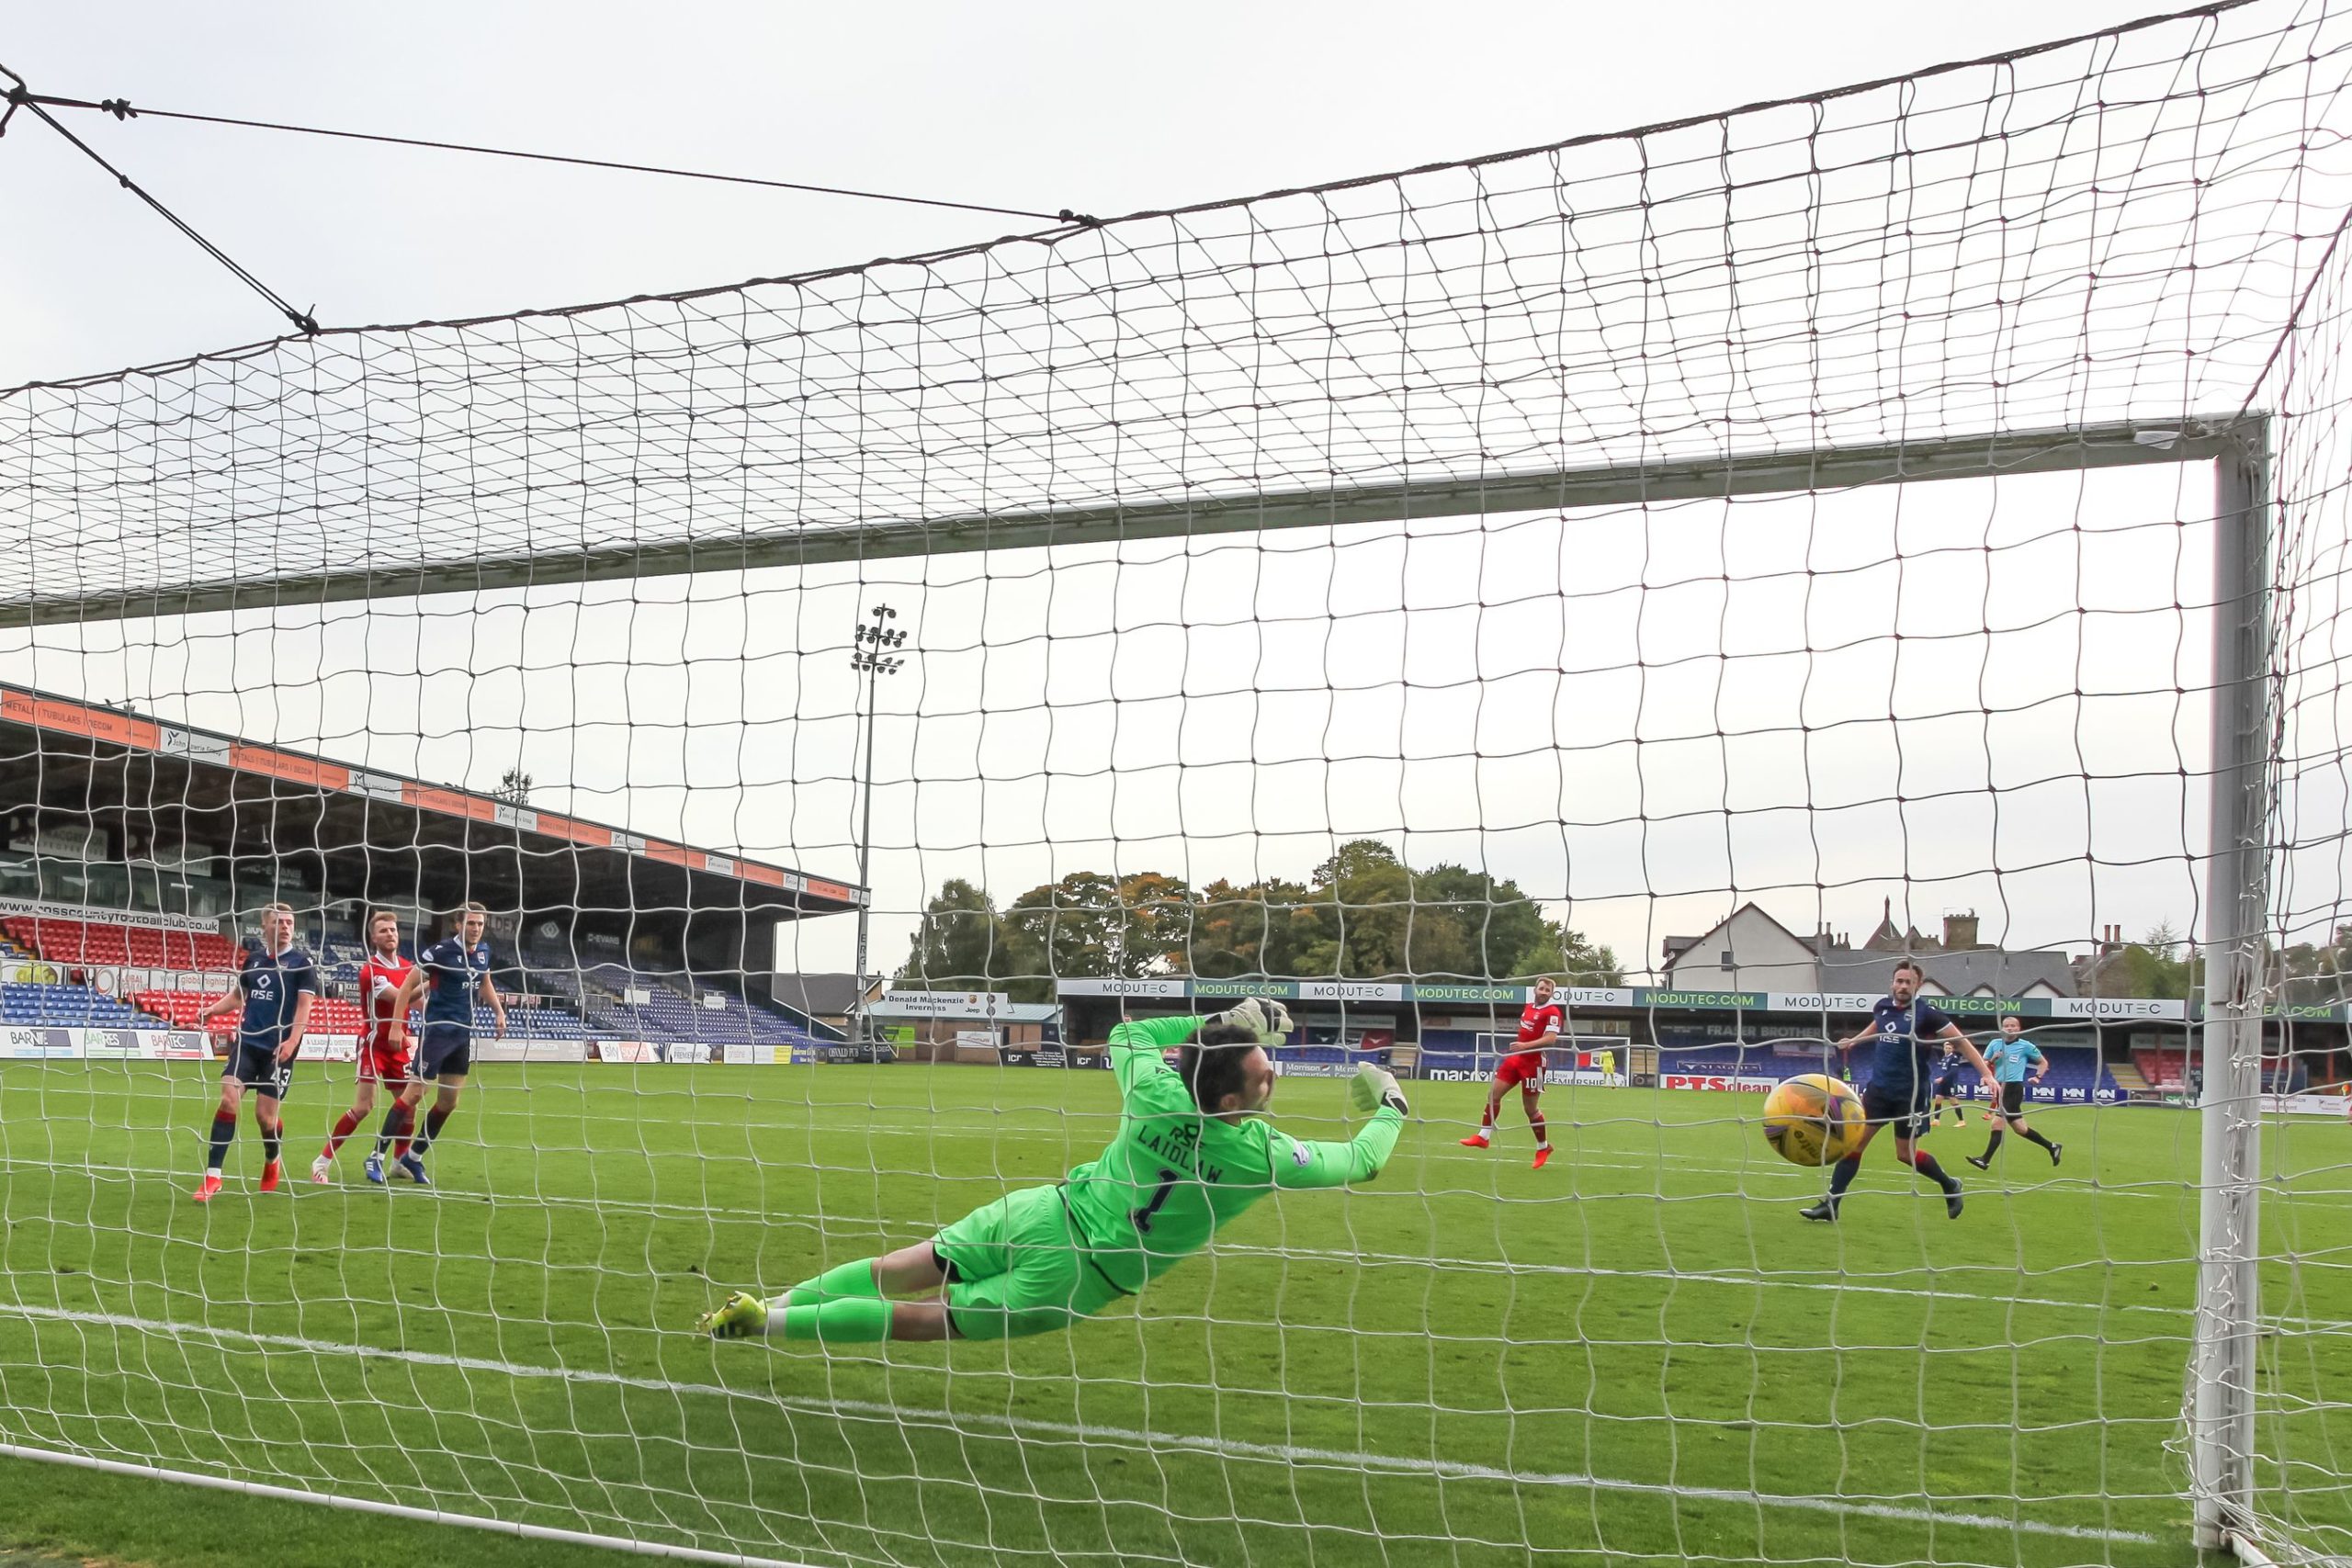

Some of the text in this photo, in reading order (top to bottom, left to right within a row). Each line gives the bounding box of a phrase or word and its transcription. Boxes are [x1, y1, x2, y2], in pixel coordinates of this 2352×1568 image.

[6, 701, 34, 715] METAL
[0, 901, 218, 931] www.rosscountyfootballclubco.uk
[1102, 983, 1168, 994] MODUTEC
[1195, 984, 1288, 996] MODUTEC.COM
[1314, 986, 1385, 998] MODUTEC
[1414, 987, 1514, 1000] MODUTEC.COM
[251, 989, 274, 1001] RSE
[888, 995, 965, 1004] Donald Mackenzie
[1553, 990, 1615, 1003] ODUTEC
[1645, 992, 1754, 1007] MODUTEC.COM
[1784, 997, 1867, 1009] MODUTEC
[1928, 998, 2021, 1011] DUTEC.COM
[2070, 1002, 2161, 1015] MODUTEC
[1760, 1026, 1830, 1038] BROTHER
[1286, 1063, 1320, 1071] Morrison
[1525, 1077, 1537, 1089] 10
[1136, 1124, 1224, 1184] LAIDLAW
[1127, 1167, 1182, 1235] 1
